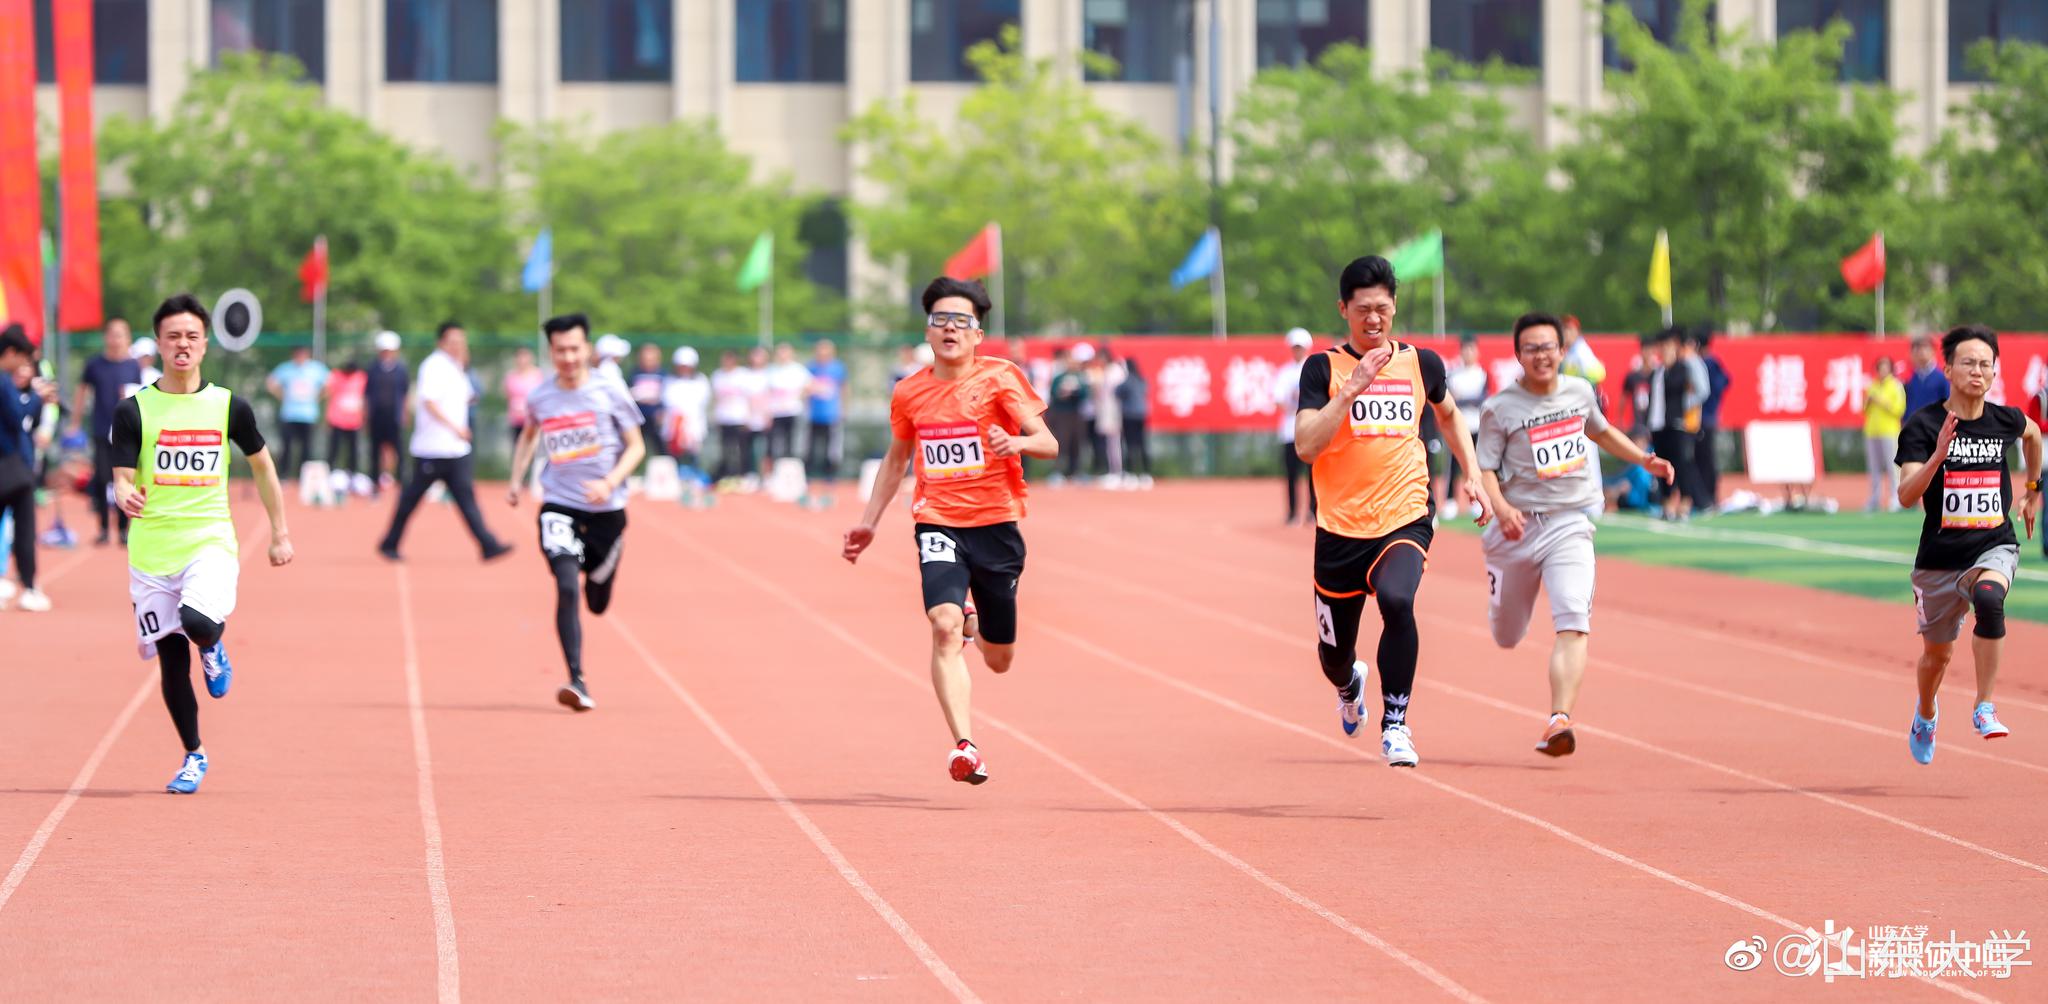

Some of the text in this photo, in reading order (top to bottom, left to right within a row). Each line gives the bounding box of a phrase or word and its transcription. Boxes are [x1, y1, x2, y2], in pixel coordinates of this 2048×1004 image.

[1352, 401, 1412, 421] 0036
[926, 442, 980, 465] 0091
[1537, 437, 1585, 466] 0126
[1947, 443, 2002, 458] FANTASY
[158, 451, 219, 471] 0067
[1945, 493, 2000, 513] 0156
[929, 537, 946, 553] 5
